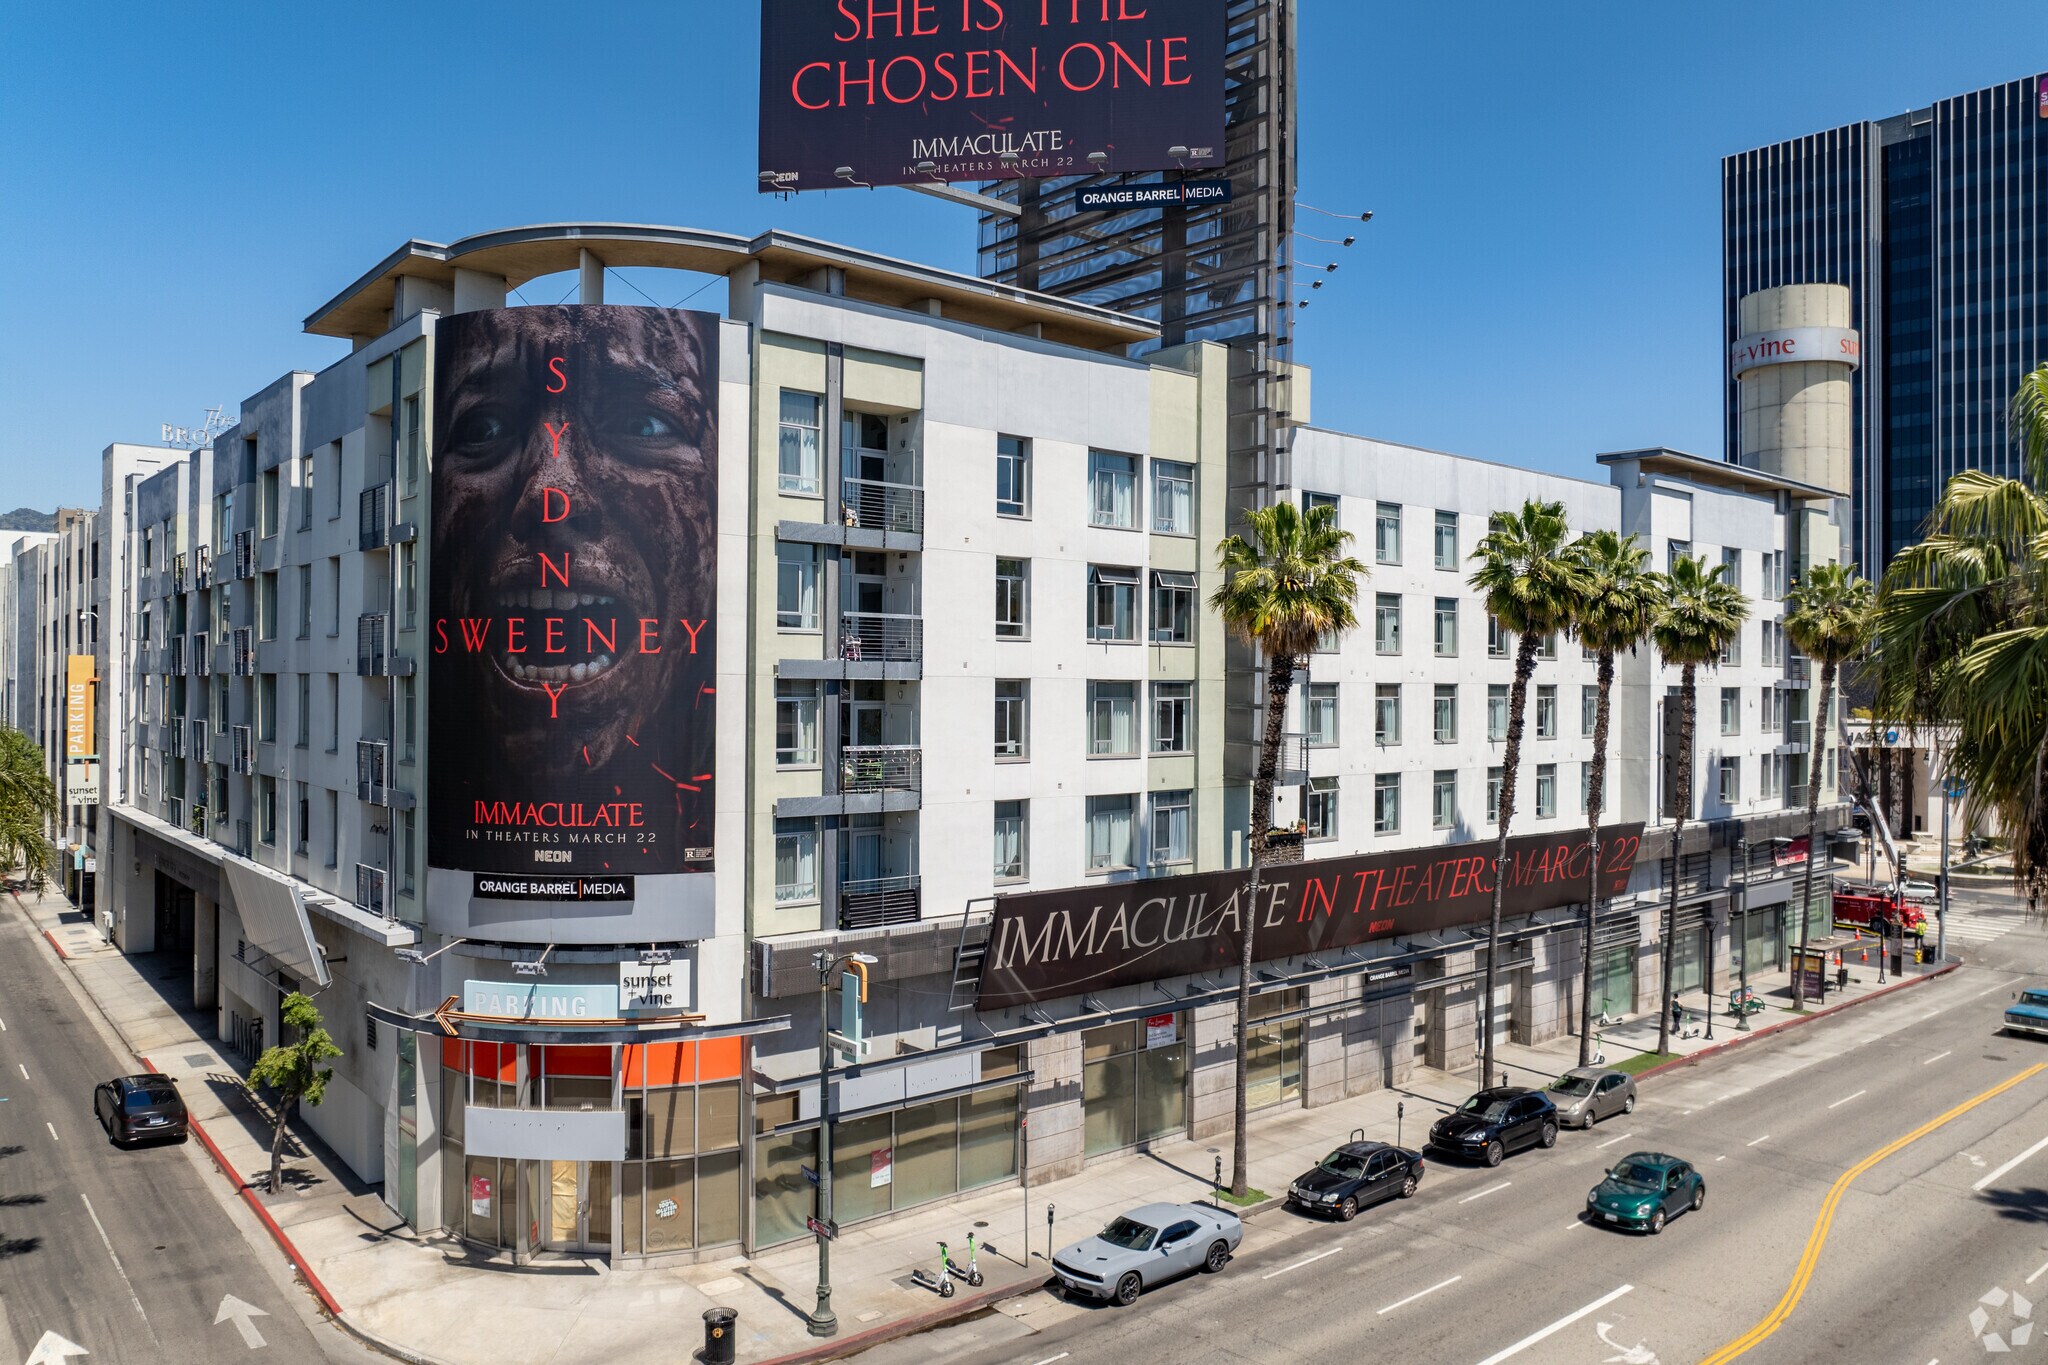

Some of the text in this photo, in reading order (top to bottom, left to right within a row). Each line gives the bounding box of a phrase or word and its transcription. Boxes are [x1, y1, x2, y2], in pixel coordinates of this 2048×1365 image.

[834, 0, 940, 42] SHE
[961, 0, 1004, 32] IS
[791, 36, 1192, 110] CHOSEN ONE
[912, 130, 1064, 159] IMMACULATE
[903, 167, 917, 175] IN
[933, 161, 993, 174] HEATERS
[1057, 156, 1074, 166] 22
[776, 171, 799, 182] EON
[1082, 186, 1224, 204] ORANGE BARREL MEDIA
[1748, 337, 1796, 360] vine
[161, 422, 221, 446] BRO
[434, 617, 708, 655] SWEENEY
[69, 683, 85, 754] PARKING
[69, 786, 98, 795] sunset
[77, 795, 98, 804] vine
[475, 800, 645, 828] IMMACULATE
[466, 829, 656, 844] IN THEATERS MARCH 22
[534, 850, 572, 863] NEON
[479, 880, 626, 895] ORANGE BARREL MEDIA
[1297, 874, 1341, 923] IN
[1605, 836, 1640, 873] 22
[623, 973, 673, 989] sunset
[474, 991, 587, 1016] PARKING
[639, 992, 673, 1008] vine
